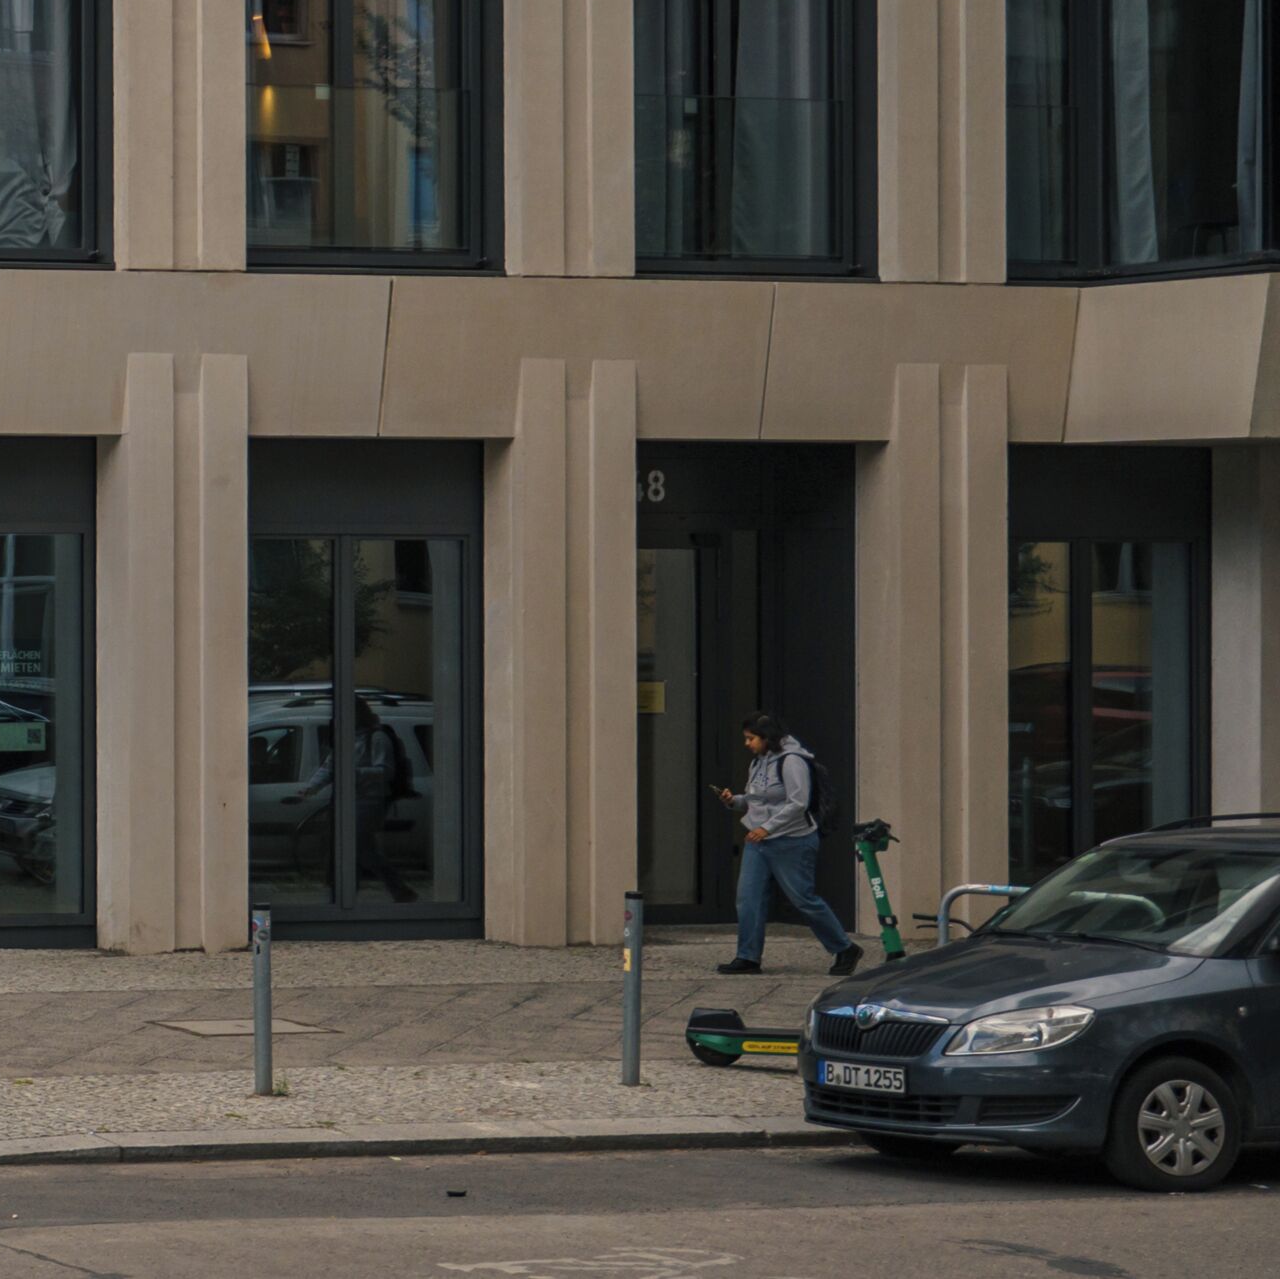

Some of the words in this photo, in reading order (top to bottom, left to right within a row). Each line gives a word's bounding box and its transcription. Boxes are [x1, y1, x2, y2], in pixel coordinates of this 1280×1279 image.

[871, 877, 885, 899] Bolt
[826, 1064, 834, 1082] B
[843, 1066, 861, 1086] DT
[864, 1068, 904, 1091] 1255
